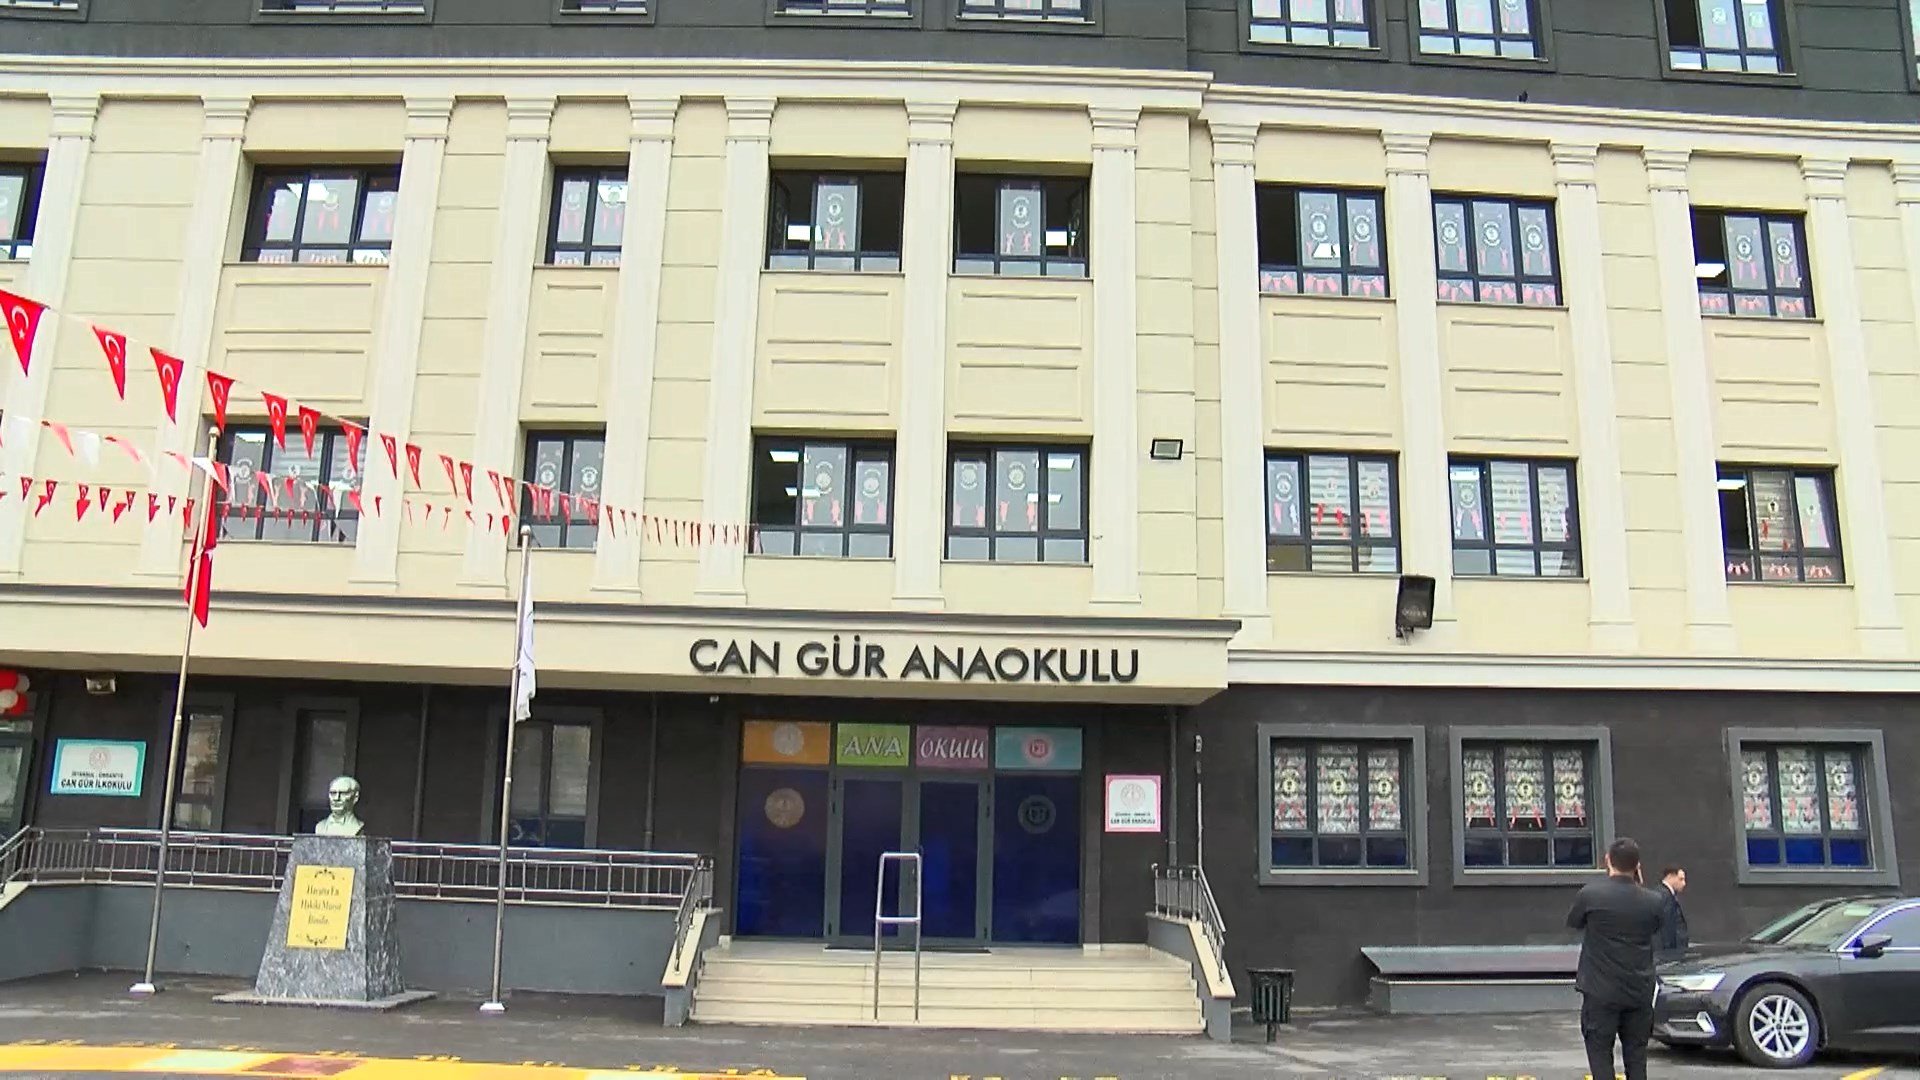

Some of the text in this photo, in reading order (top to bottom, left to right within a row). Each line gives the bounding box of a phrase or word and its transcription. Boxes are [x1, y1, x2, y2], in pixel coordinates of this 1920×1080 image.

[690, 635, 1139, 682] CAN GÜR ANAOKULU
[843, 735, 985, 760] ANA OKULU
